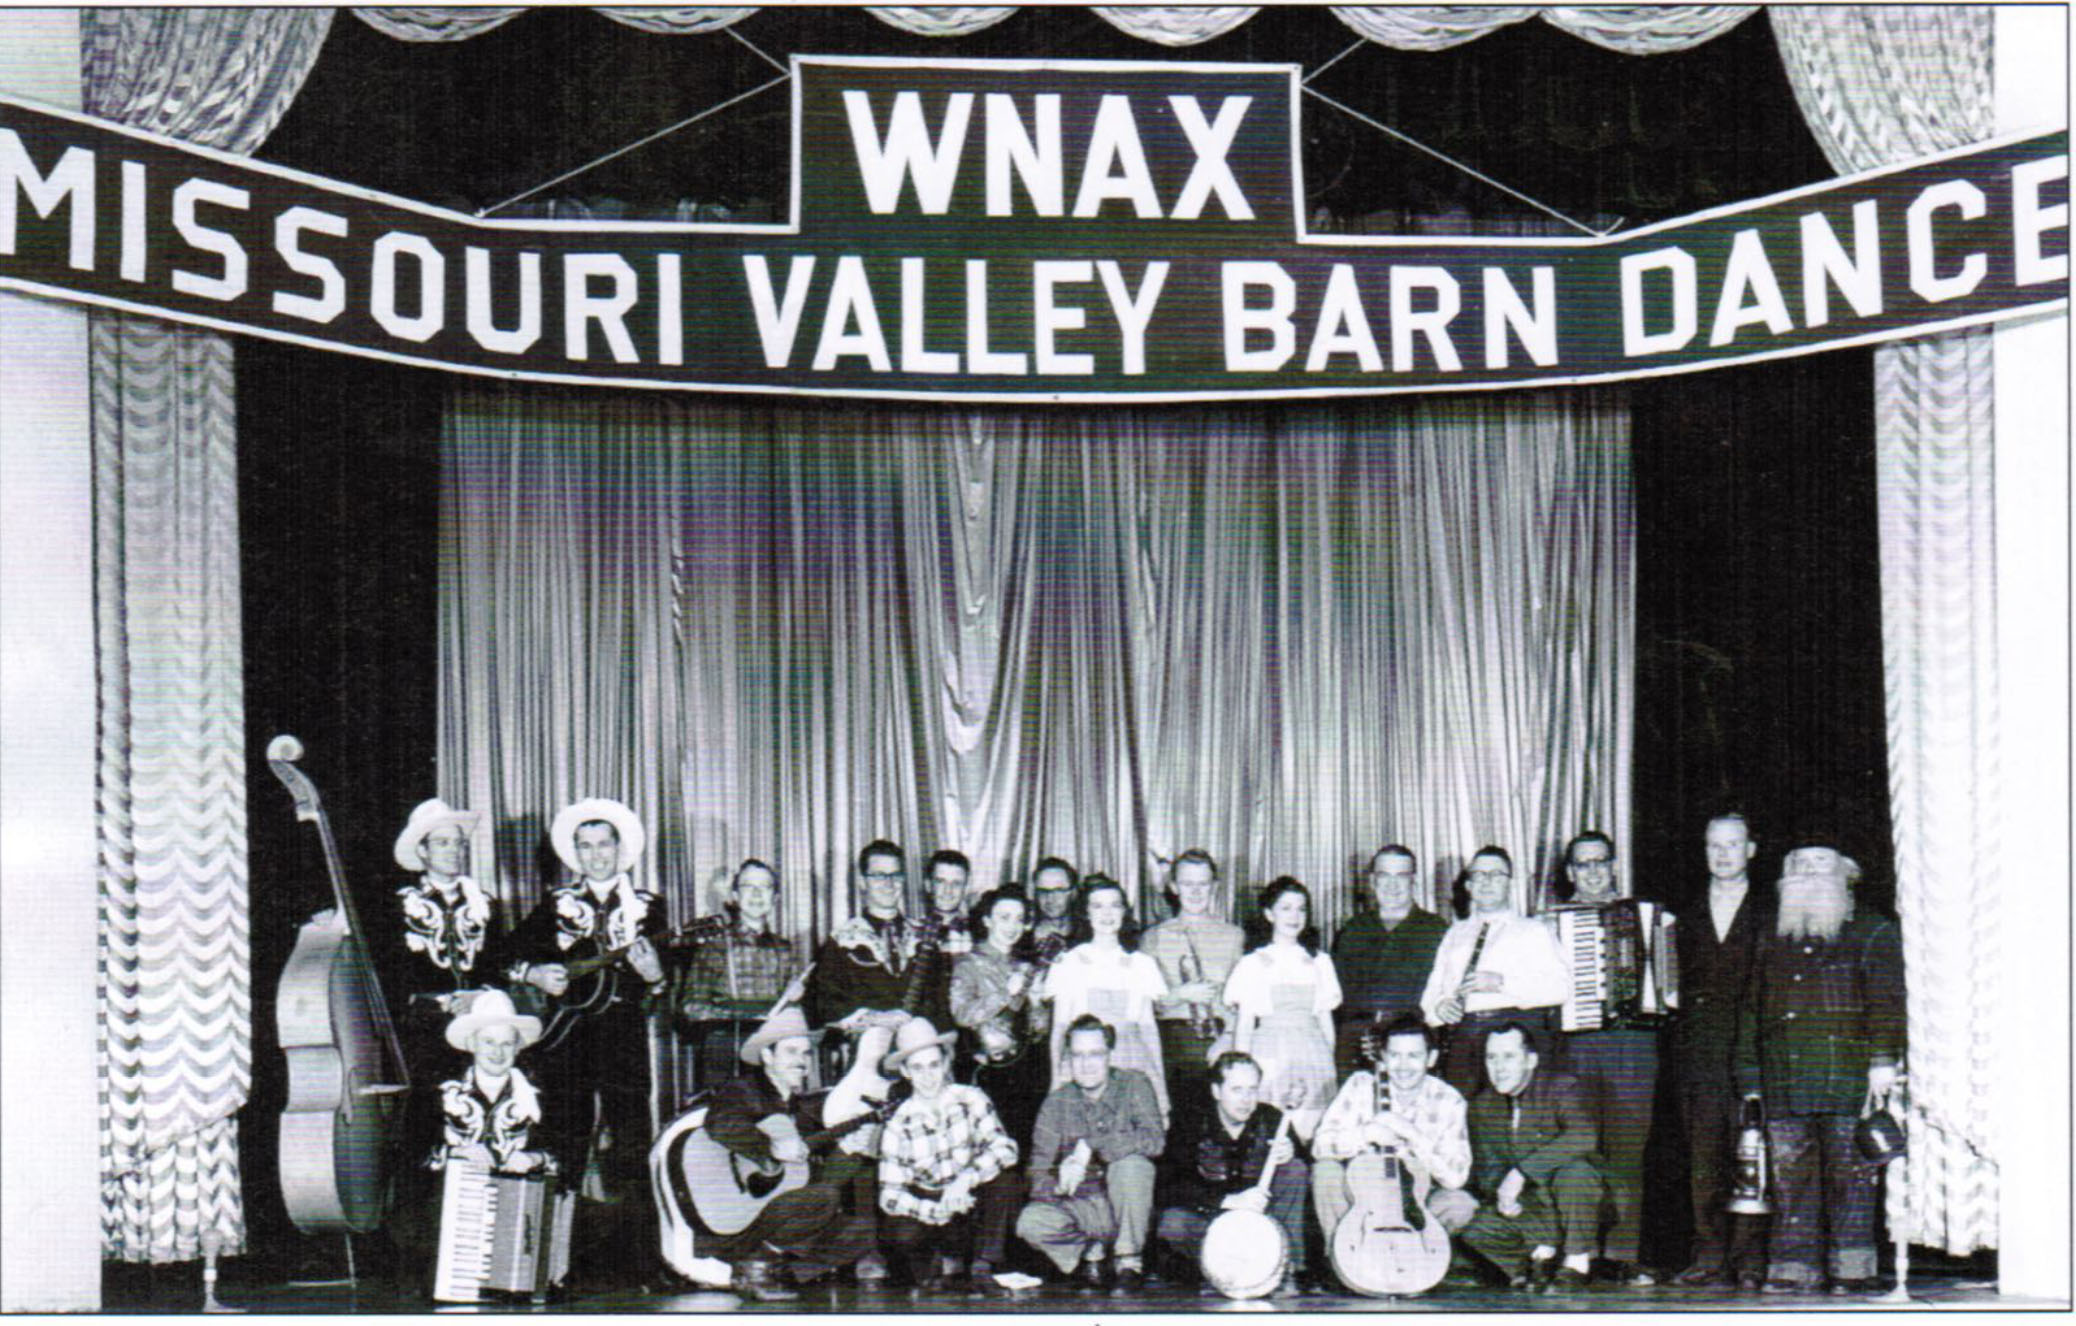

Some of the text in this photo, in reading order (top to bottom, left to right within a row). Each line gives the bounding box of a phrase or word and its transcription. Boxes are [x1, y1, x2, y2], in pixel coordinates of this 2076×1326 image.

[842, 90, 1255, 221] WNAX
[0, 128, 2069, 376] MISSOURI VALLEY BARN DANCE
